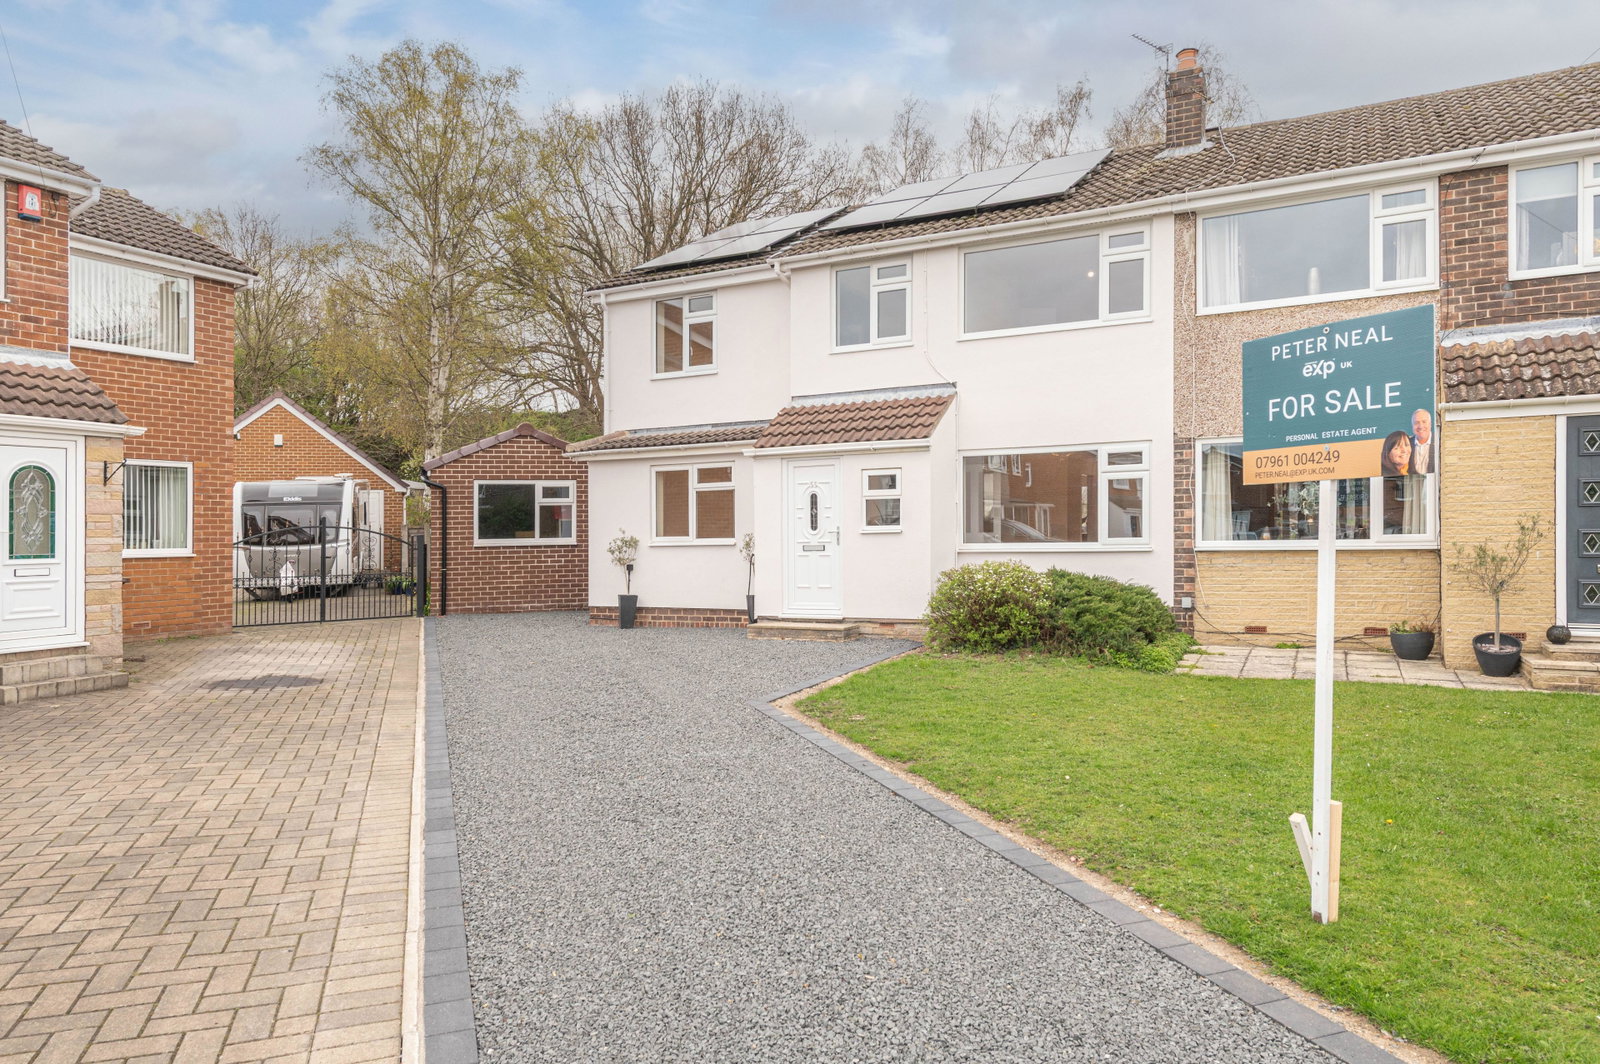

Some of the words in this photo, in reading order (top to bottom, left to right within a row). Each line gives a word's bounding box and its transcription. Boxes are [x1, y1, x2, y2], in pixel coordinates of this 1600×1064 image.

[1271, 336, 1328, 361] PETER
[1335, 325, 1393, 349] NEAL
[1340, 360, 1353, 369] UK
[1268, 393, 1316, 422] FOR
[1324, 381, 1402, 414] SALE
[1285, 432, 1319, 443] PERSONAL
[1321, 429, 1350, 439] ESTATE
[1350, 426, 1377, 436] AGENT
[1255, 454, 1289, 469] 07961
[1293, 449, 1340, 466] 004249
